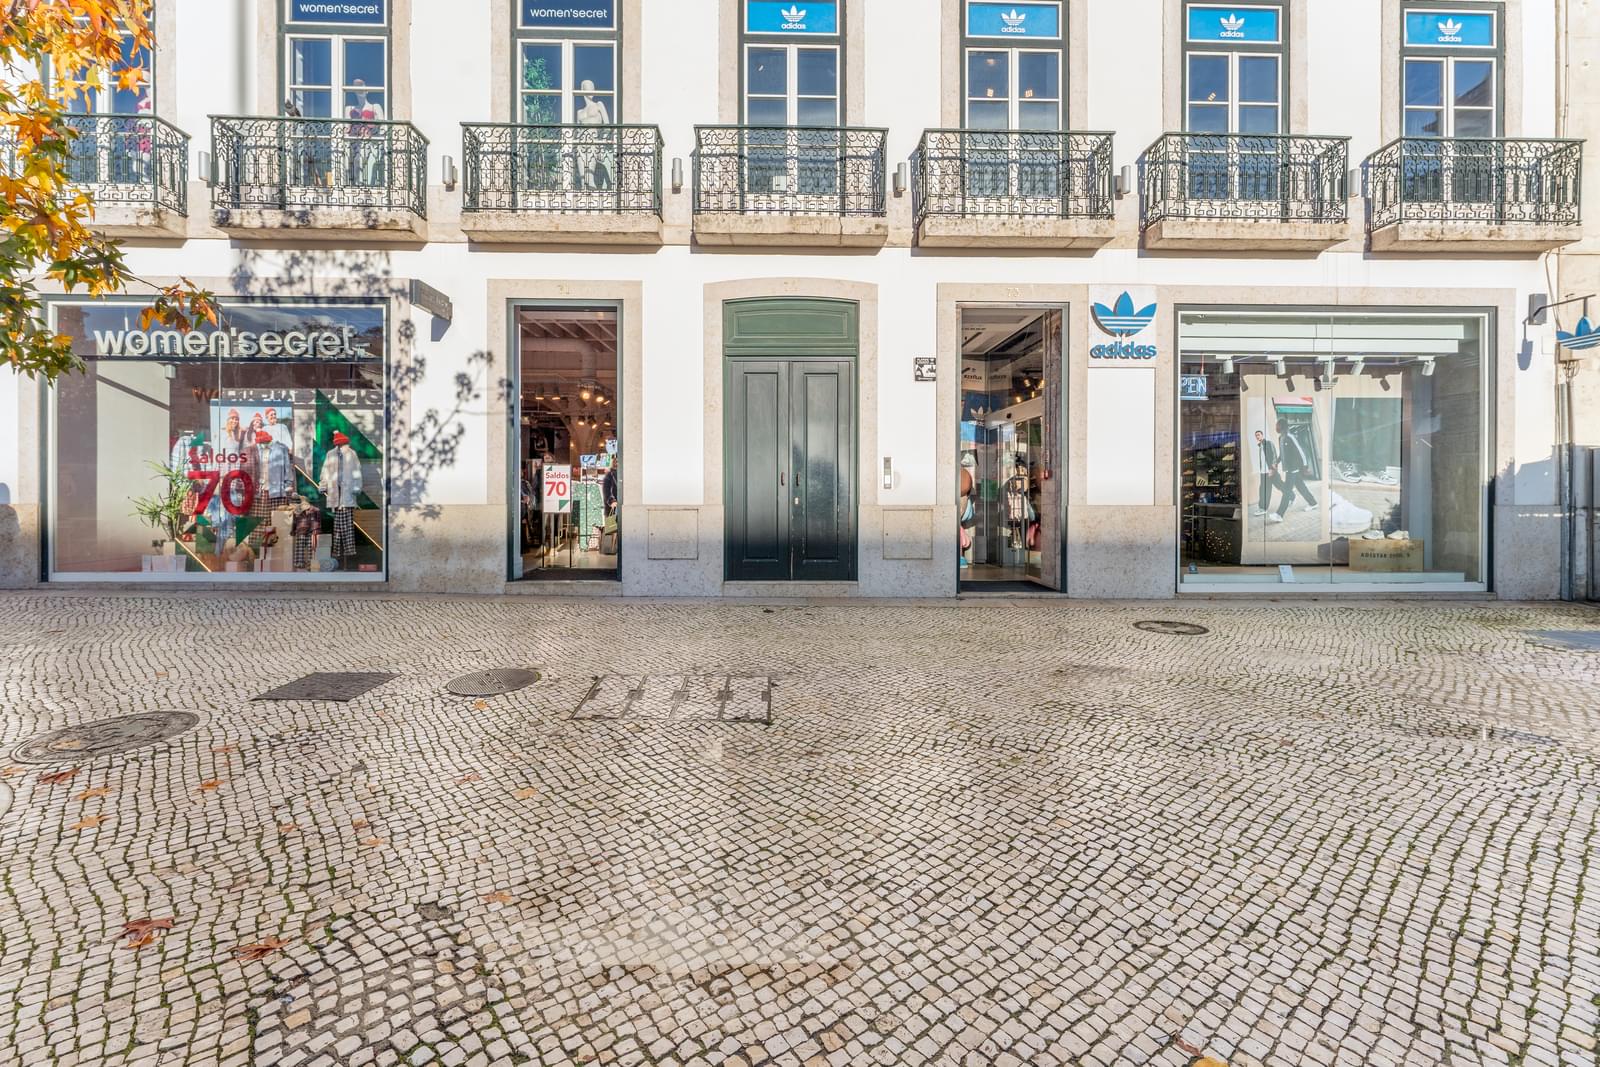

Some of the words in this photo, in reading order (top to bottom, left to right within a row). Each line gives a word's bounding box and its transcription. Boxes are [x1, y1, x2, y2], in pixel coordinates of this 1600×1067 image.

[299, 3, 379, 14] women'secret
[530, 8, 608, 18] women'secret
[781, 22, 806, 30] adidas
[94, 327, 355, 356] women'secret
[1090, 341, 1157, 360] adidas
[1181, 376, 1207, 393] PEN
[188, 446, 248, 465] Saldos
[188, 470, 255, 516] 70
[545, 481, 567, 497] 70
